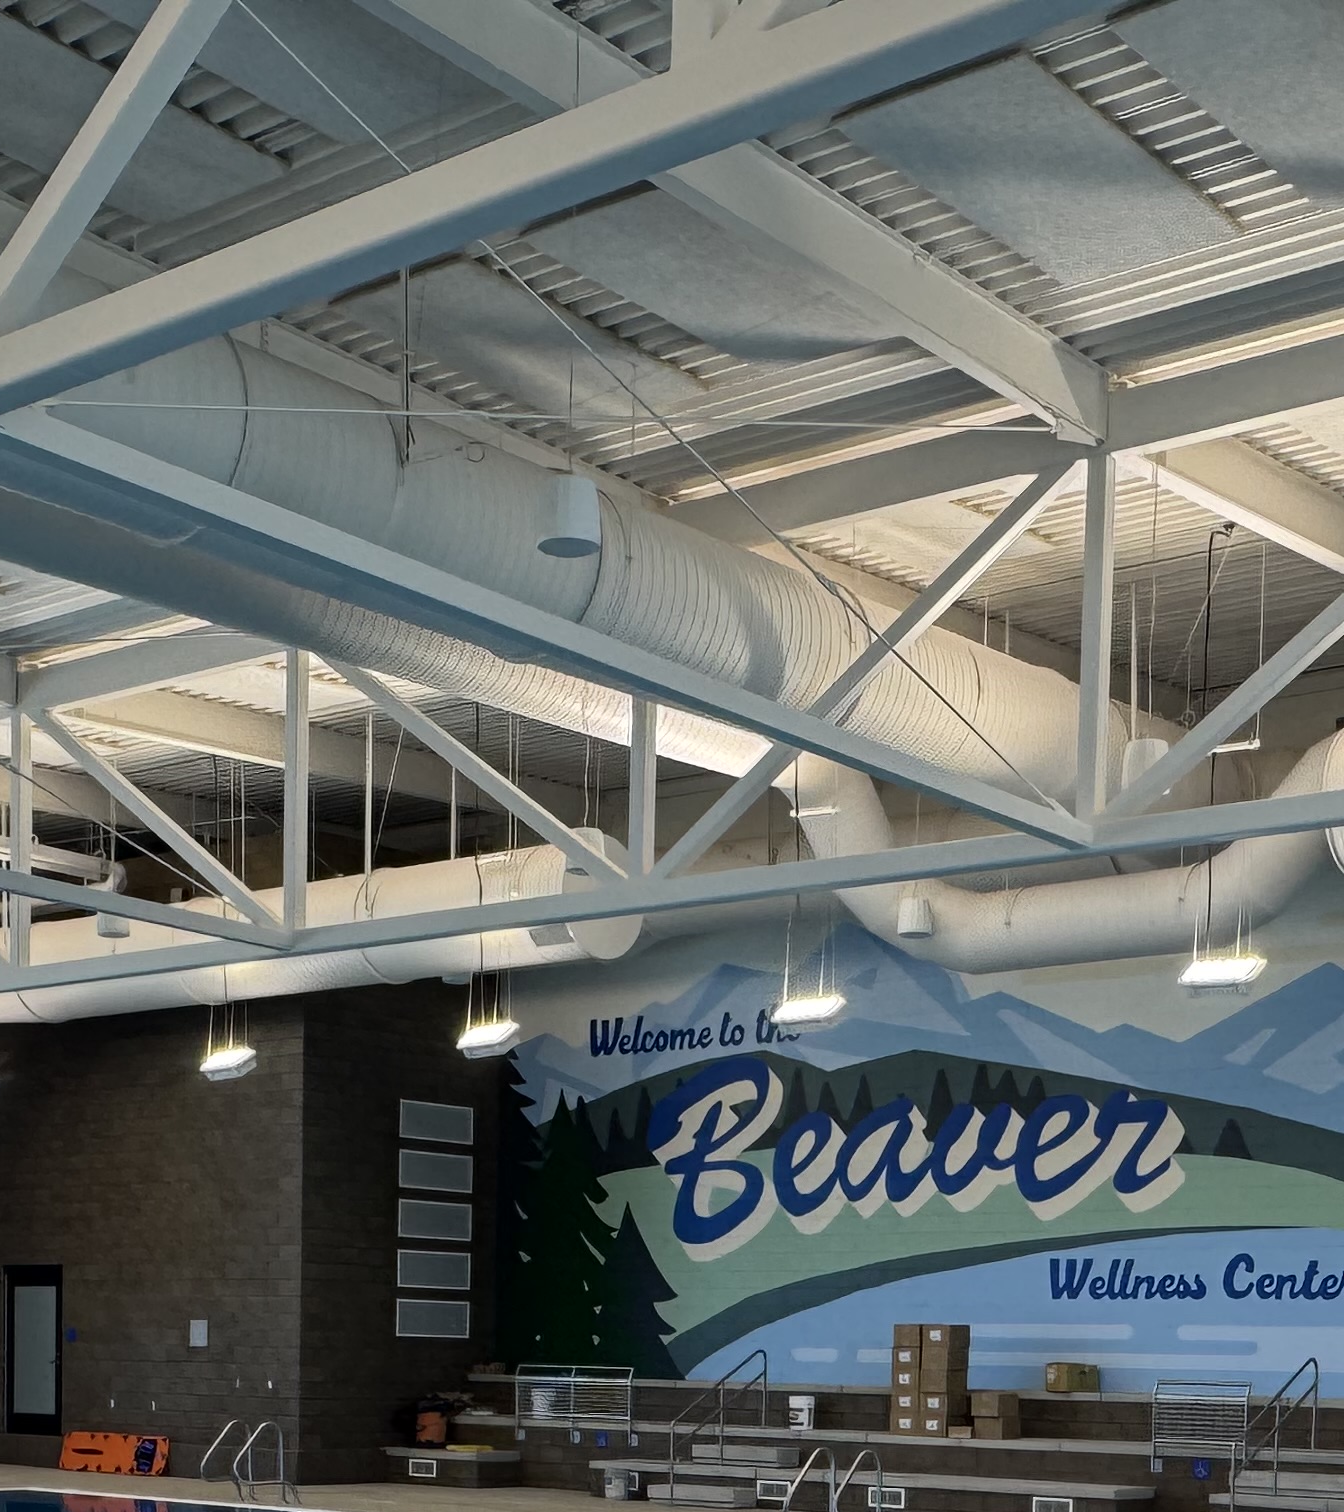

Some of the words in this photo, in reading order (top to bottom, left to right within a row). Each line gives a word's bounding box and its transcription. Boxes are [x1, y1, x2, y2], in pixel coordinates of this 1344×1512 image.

[589, 1015, 713, 1057] Welcome
[719, 1011, 745, 1047] to
[756, 1008, 800, 1043] th
[647, 1057, 1185, 1262] Beaver
[1049, 1258, 1207, 1300] Wellness
